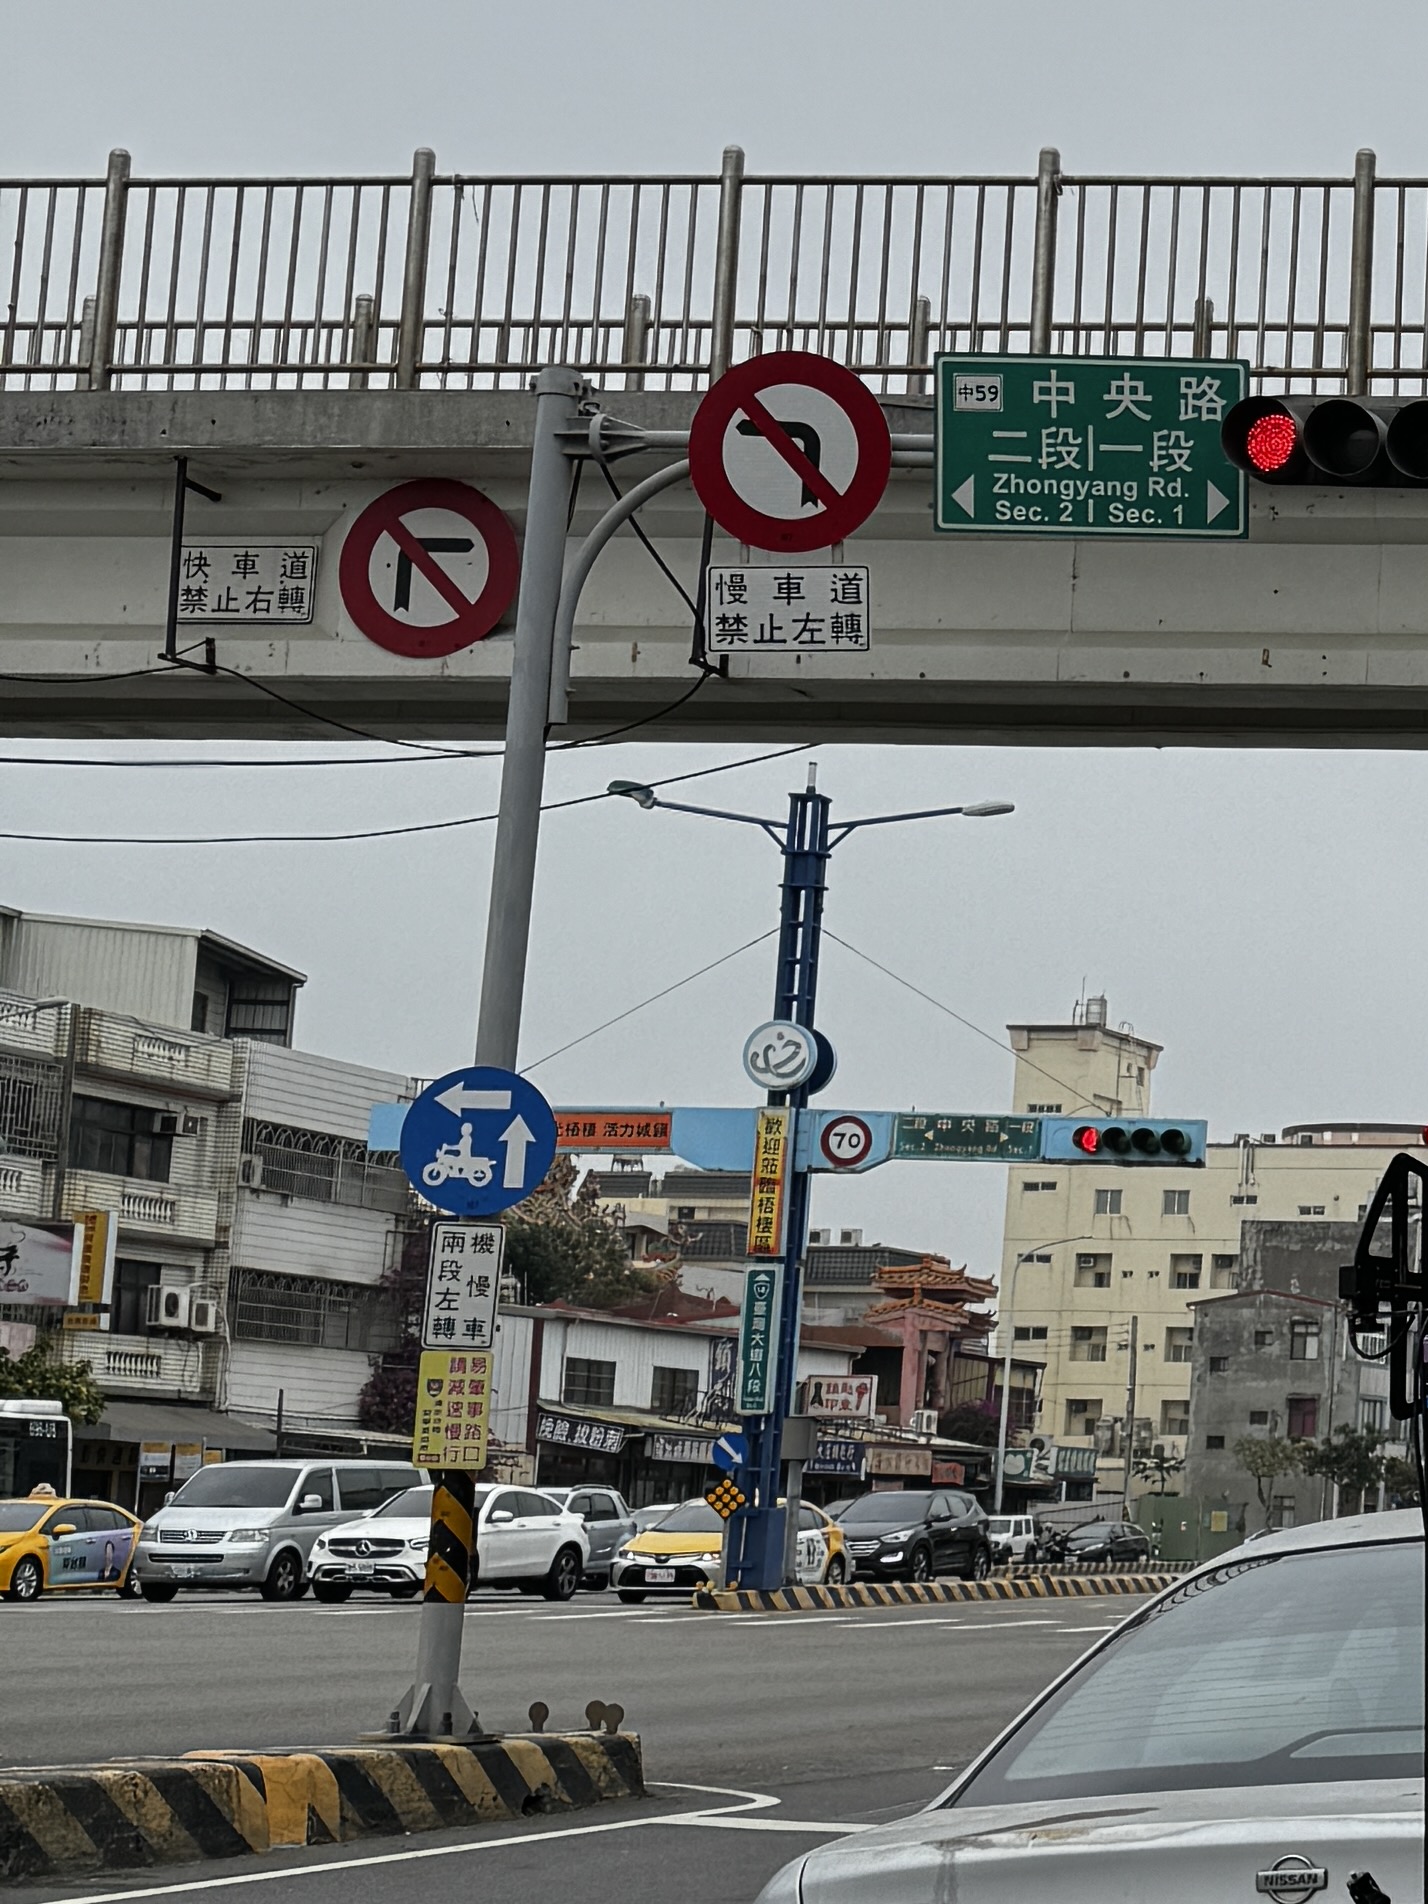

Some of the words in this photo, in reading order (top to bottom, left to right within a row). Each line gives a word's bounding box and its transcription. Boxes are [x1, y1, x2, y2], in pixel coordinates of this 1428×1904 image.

[958, 383, 999, 402] 中59
[1033, 369, 1227, 422] 中央路
[988, 425, 1082, 470] 二段
[1099, 429, 1194, 472] 一段
[992, 473, 1138, 501] Zhongyang
[1149, 477, 1190, 498] Rd.
[995, 500, 1048, 522] Sec.
[1059, 502, 1074, 522] 2
[1108, 502, 1162, 524] Sec.
[1173, 504, 1184, 524] 1
[183, 550, 309, 580] 快車道
[180, 585, 306, 615] 禁止右轉
[715, 572, 864, 606] 慢車道
[715, 611, 866, 645] 禁止左轉
[833, 1132, 861, 1149] 70
[432, 1231, 466, 1340] 兩段左轉
[462, 1232, 495, 1341] 機慢車
[1263, 1872, 1319, 1888] NISSAN
